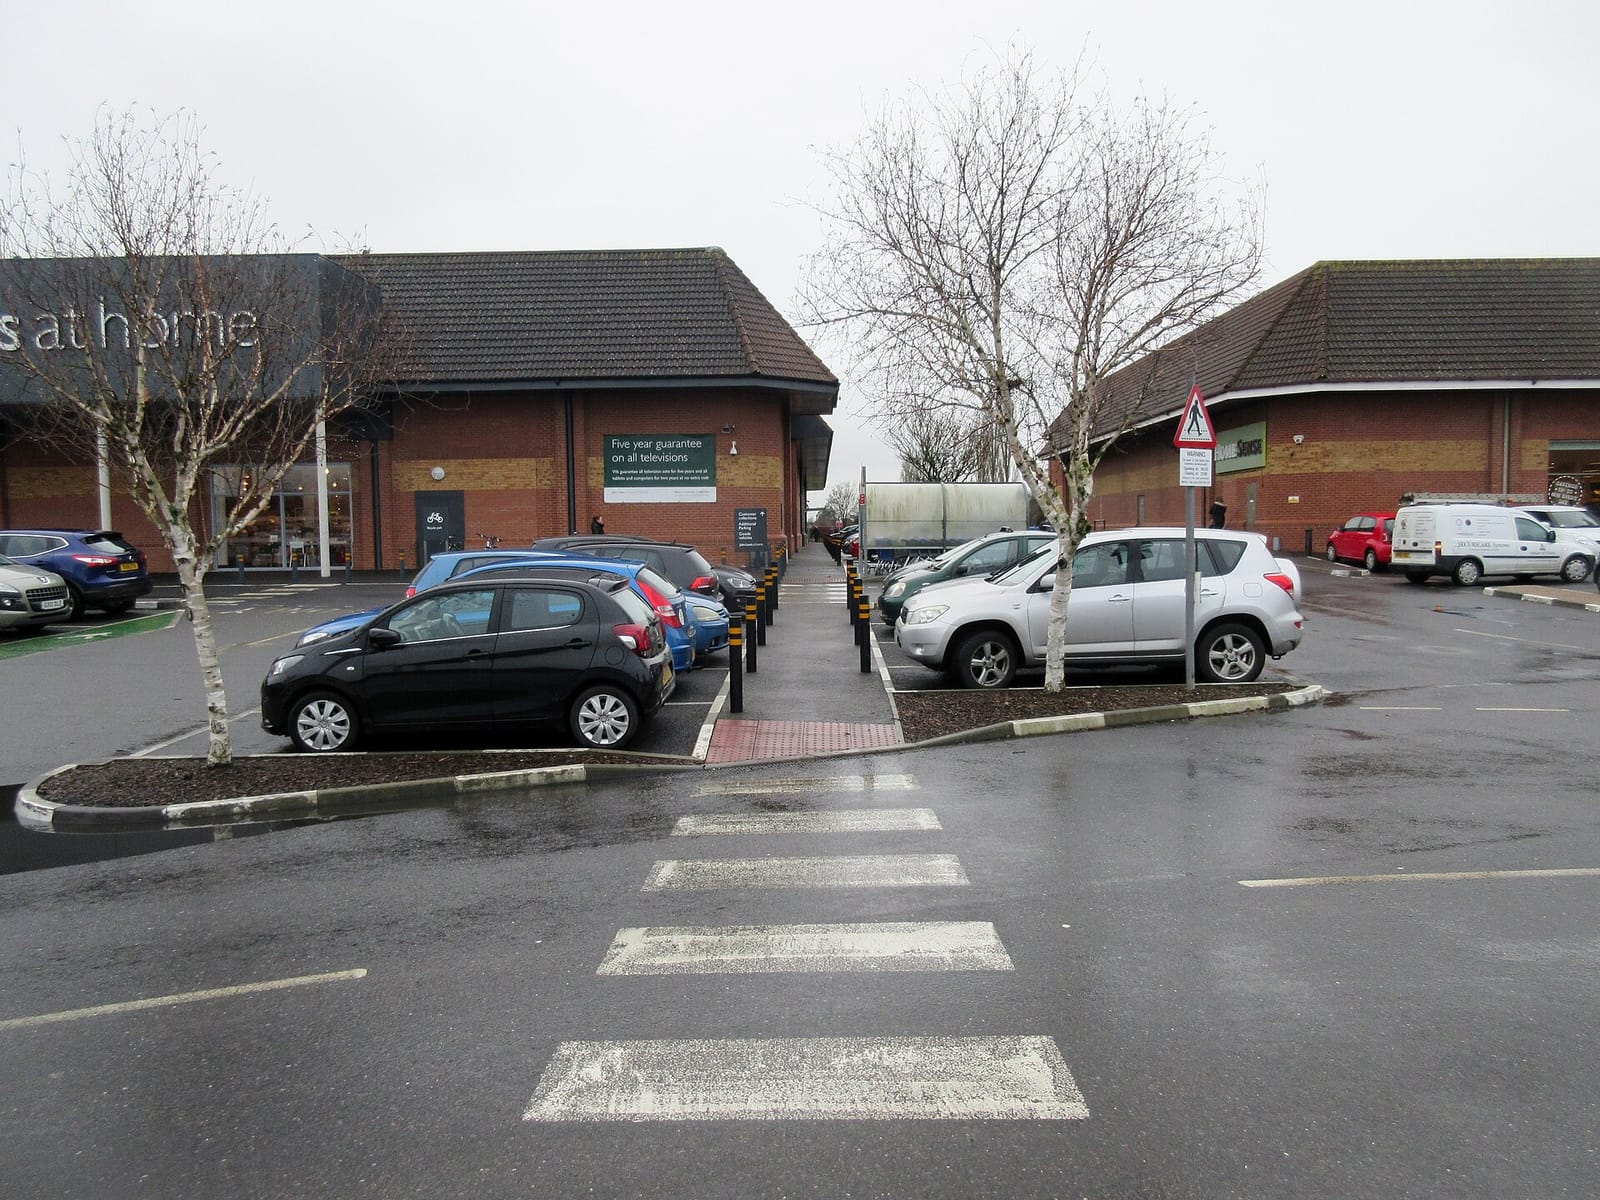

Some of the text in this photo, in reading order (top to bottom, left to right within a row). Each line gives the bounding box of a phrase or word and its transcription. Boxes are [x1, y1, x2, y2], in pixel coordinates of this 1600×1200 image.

[35, 309, 85, 350] at
[99, 295, 260, 349] home
[611, 439, 702, 451] Five year guarantee
[627, 452, 638, 462] all
[640, 452, 689, 462] televisions
[1186, 450, 1206, 458] WARNING
